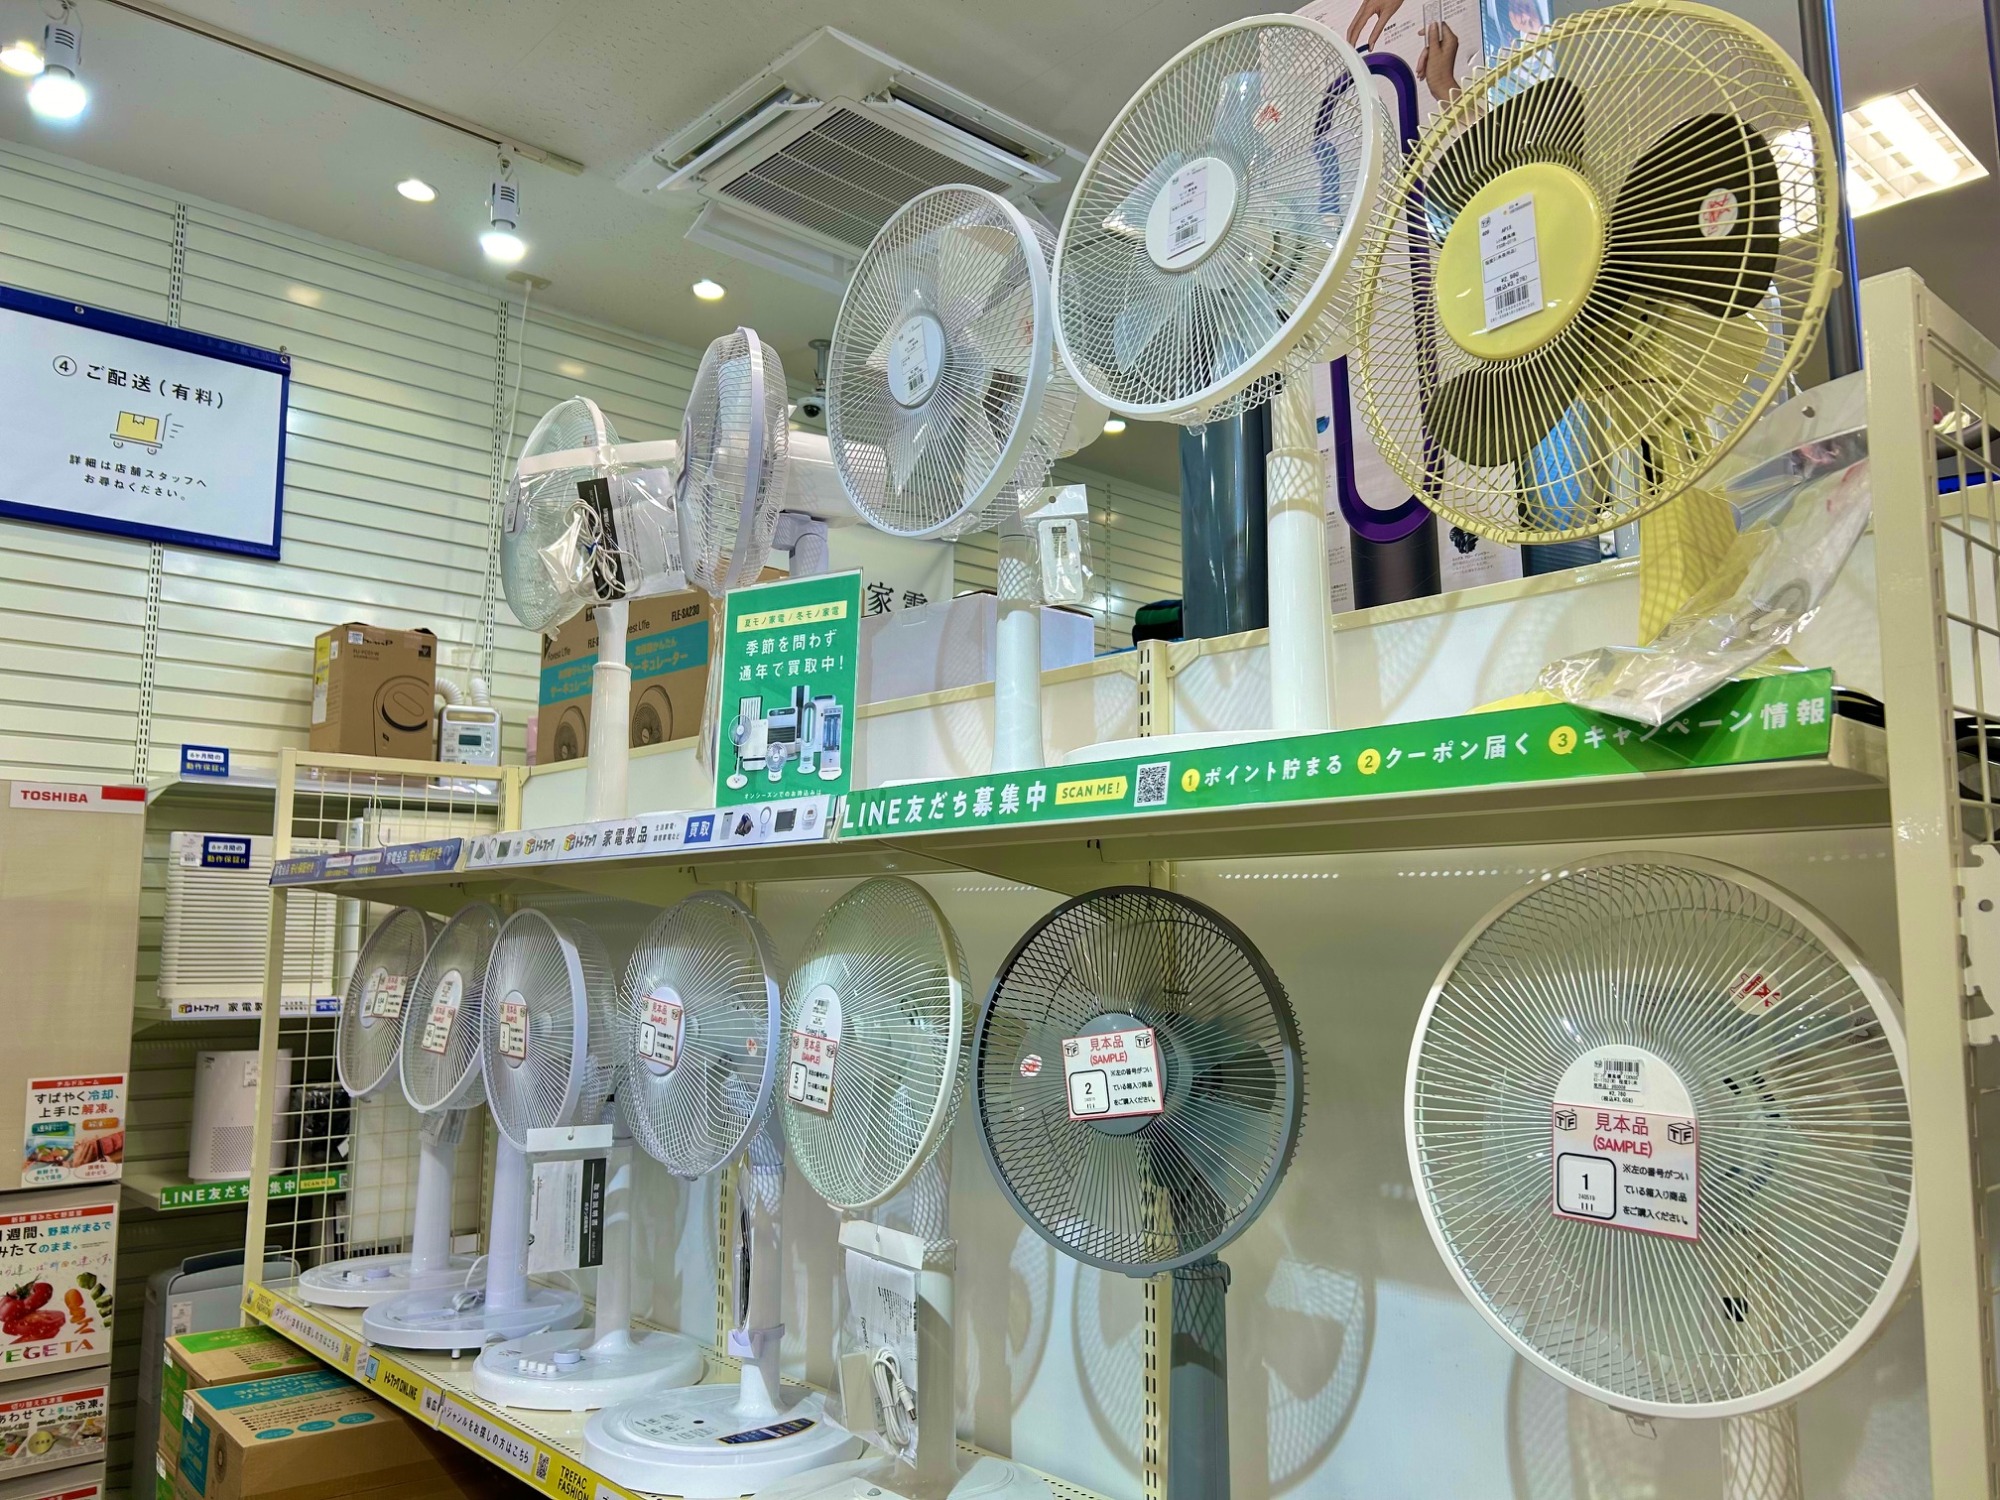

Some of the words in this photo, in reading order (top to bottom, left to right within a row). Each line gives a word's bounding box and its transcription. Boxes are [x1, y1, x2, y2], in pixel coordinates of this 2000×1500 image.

[86, 363, 224, 409] ご配送(有料)
[69, 454, 207, 488] 詳細は店舗スタッフへ
[84, 473, 186, 501] お尋ねください。
[745, 628, 838, 657] 季節を問わず
[738, 655, 843, 682] 通年で買取中!
[1558, 733, 1568, 747] 3
[1364, 755, 1374, 768] 2
[1385, 732, 1529, 769] クーポン届く
[1203, 754, 1343, 787] ポイント貯まる
[21, 790, 88, 804] TOSHIBA
[1061, 785, 1092, 799] SCAN
[841, 780, 1047, 829] LINE友だち募集中
[602, 825, 648, 847] 家電製品
[688, 820, 710, 838] 買取
[575, 834, 598, 848] トレファク
[803, 1038, 821, 1053] 見本品
[1090, 1035, 1124, 1052] 見本品
[1089, 1051, 1128, 1067] (SAMPLE)
[794, 1072, 800, 1084] 5
[34, 1089, 119, 1104] すばやく冷却、
[1084, 1082, 1093, 1095] 2
[38, 1103, 114, 1118] 上手に解凍。
[1595, 1112, 1649, 1136] 見本品
[1593, 1135, 1653, 1158] (SAMPLE)
[1622, 1163, 1689, 1181] ※左の番号がつい
[1581, 1173, 1589, 1191] 1
[161, 1180, 297, 1205] LINE友だち集中
[1624, 1184, 1688, 1202] ている箱入り商品
[1622, 1206, 1689, 1225] をご購入ください。
[560, 1465, 587, 1490] TREFAC
